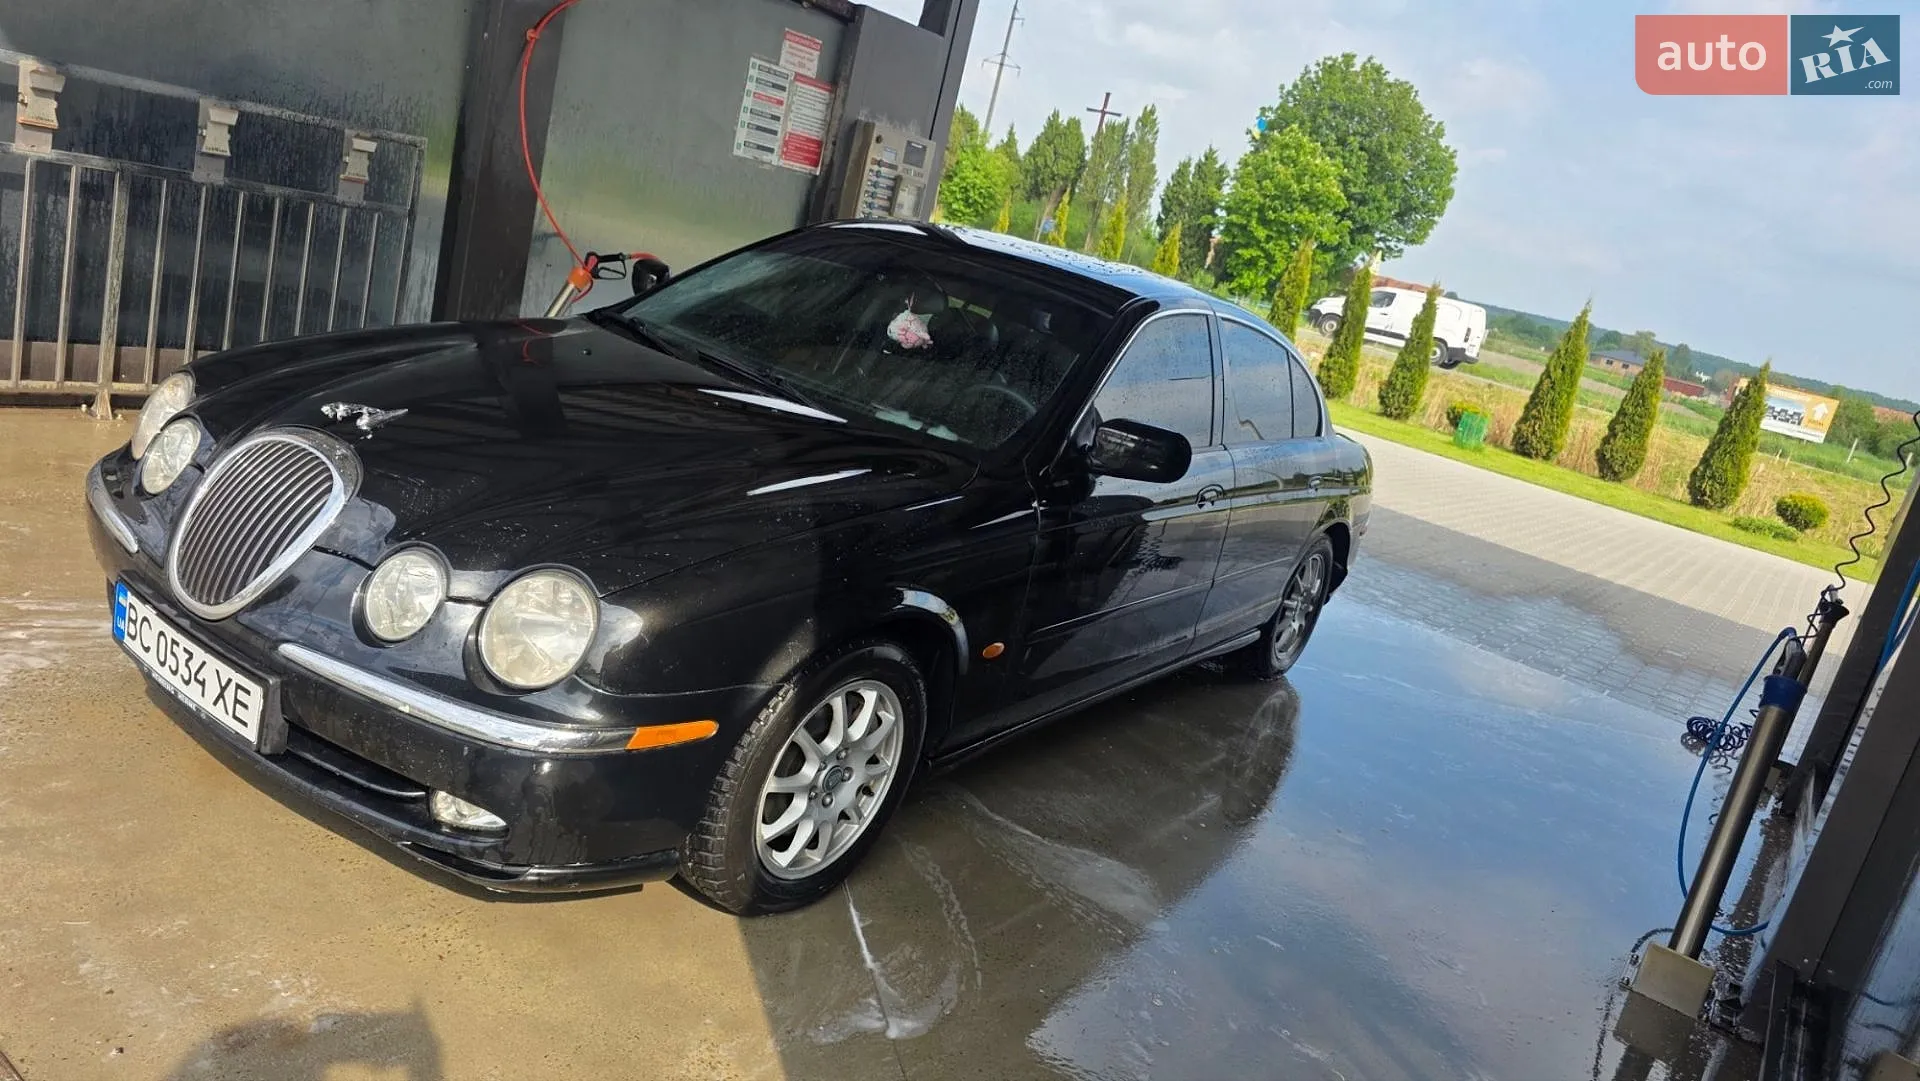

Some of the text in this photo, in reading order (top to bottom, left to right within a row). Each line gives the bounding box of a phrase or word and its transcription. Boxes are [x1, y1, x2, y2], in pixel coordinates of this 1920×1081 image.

[116, 616, 125, 632] UA
[126, 601, 251, 729] BC 0534 XE
